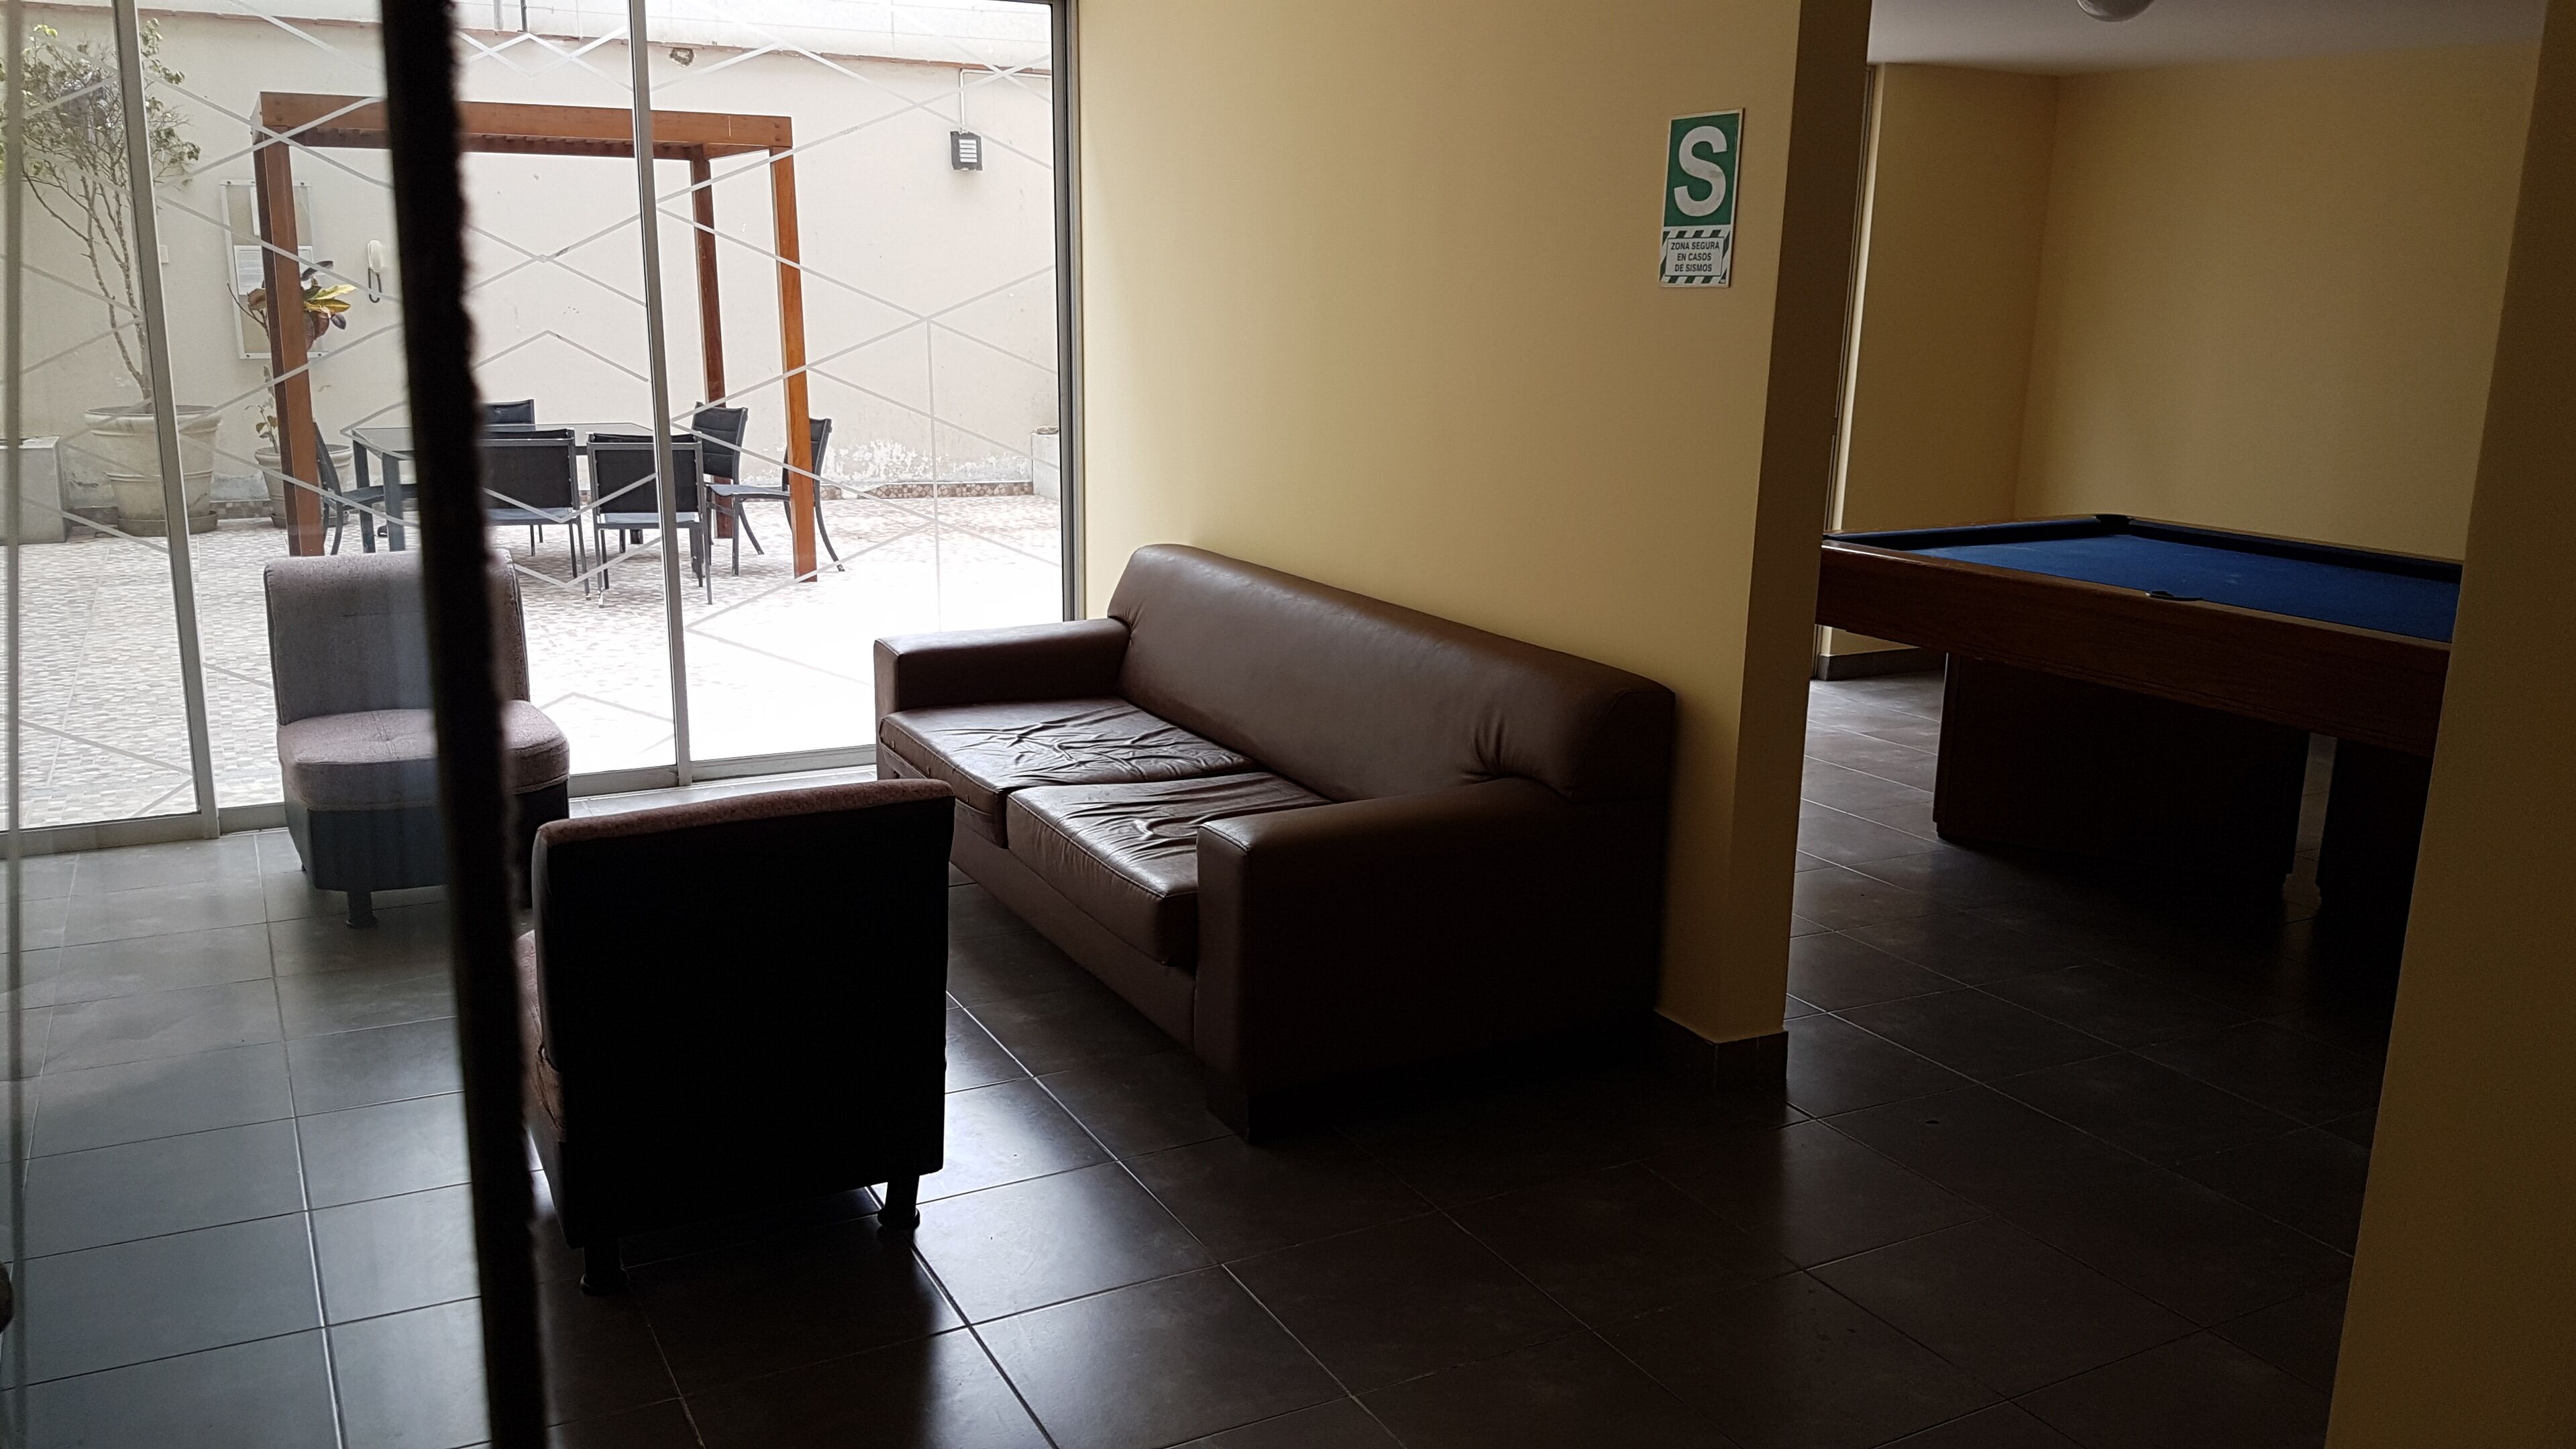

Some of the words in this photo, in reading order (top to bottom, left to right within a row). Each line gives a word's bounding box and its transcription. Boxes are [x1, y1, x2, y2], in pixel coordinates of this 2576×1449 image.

[1674, 125, 1727, 217] S
[1670, 241, 1690, 250] ZONA
[1691, 241, 1720, 250] SEGURA
[1677, 253, 1686, 261] EN
[1688, 252, 1712, 261] CASOS
[1674, 264, 1684, 272] DE
[1685, 264, 1712, 272] SISMOS
